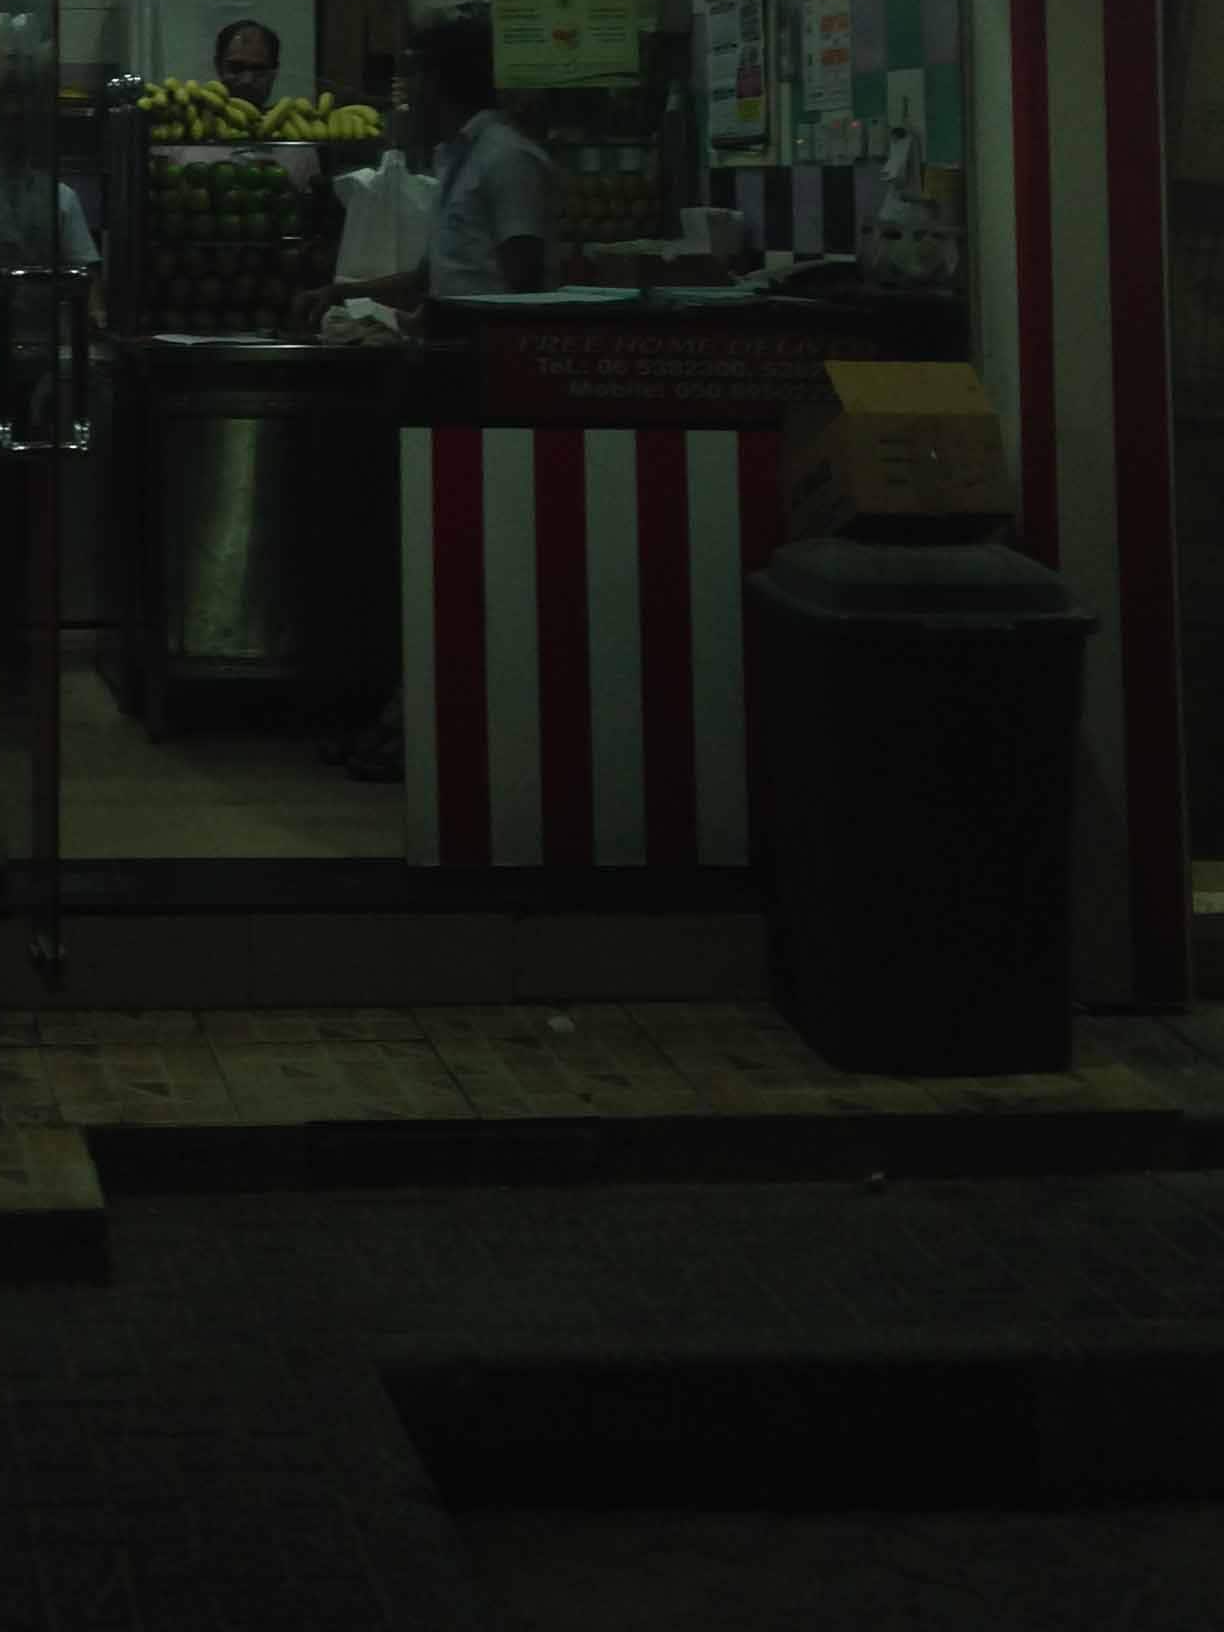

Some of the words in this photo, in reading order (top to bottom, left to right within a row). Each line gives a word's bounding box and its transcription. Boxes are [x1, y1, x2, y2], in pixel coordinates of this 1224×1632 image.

[519, 335, 602, 354] FREE
[614, 335, 713, 354] HOME
[672, 381, 722, 400] 050
